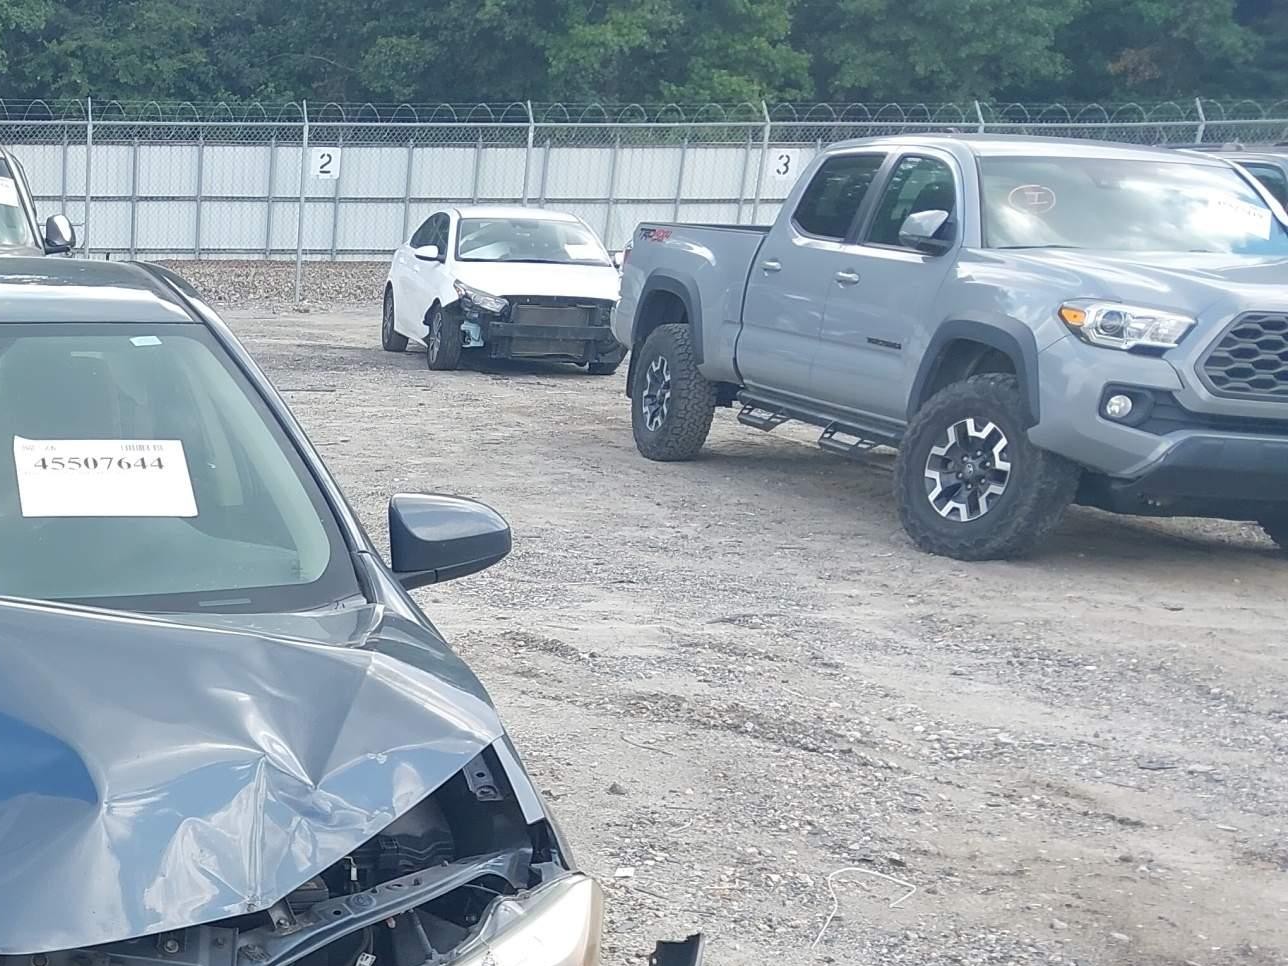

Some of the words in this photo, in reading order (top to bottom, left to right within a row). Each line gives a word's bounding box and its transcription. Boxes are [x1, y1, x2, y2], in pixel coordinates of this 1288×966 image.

[319, 153, 332, 174] 2
[776, 154, 790, 175] 3
[34, 457, 164, 470] 45507644
